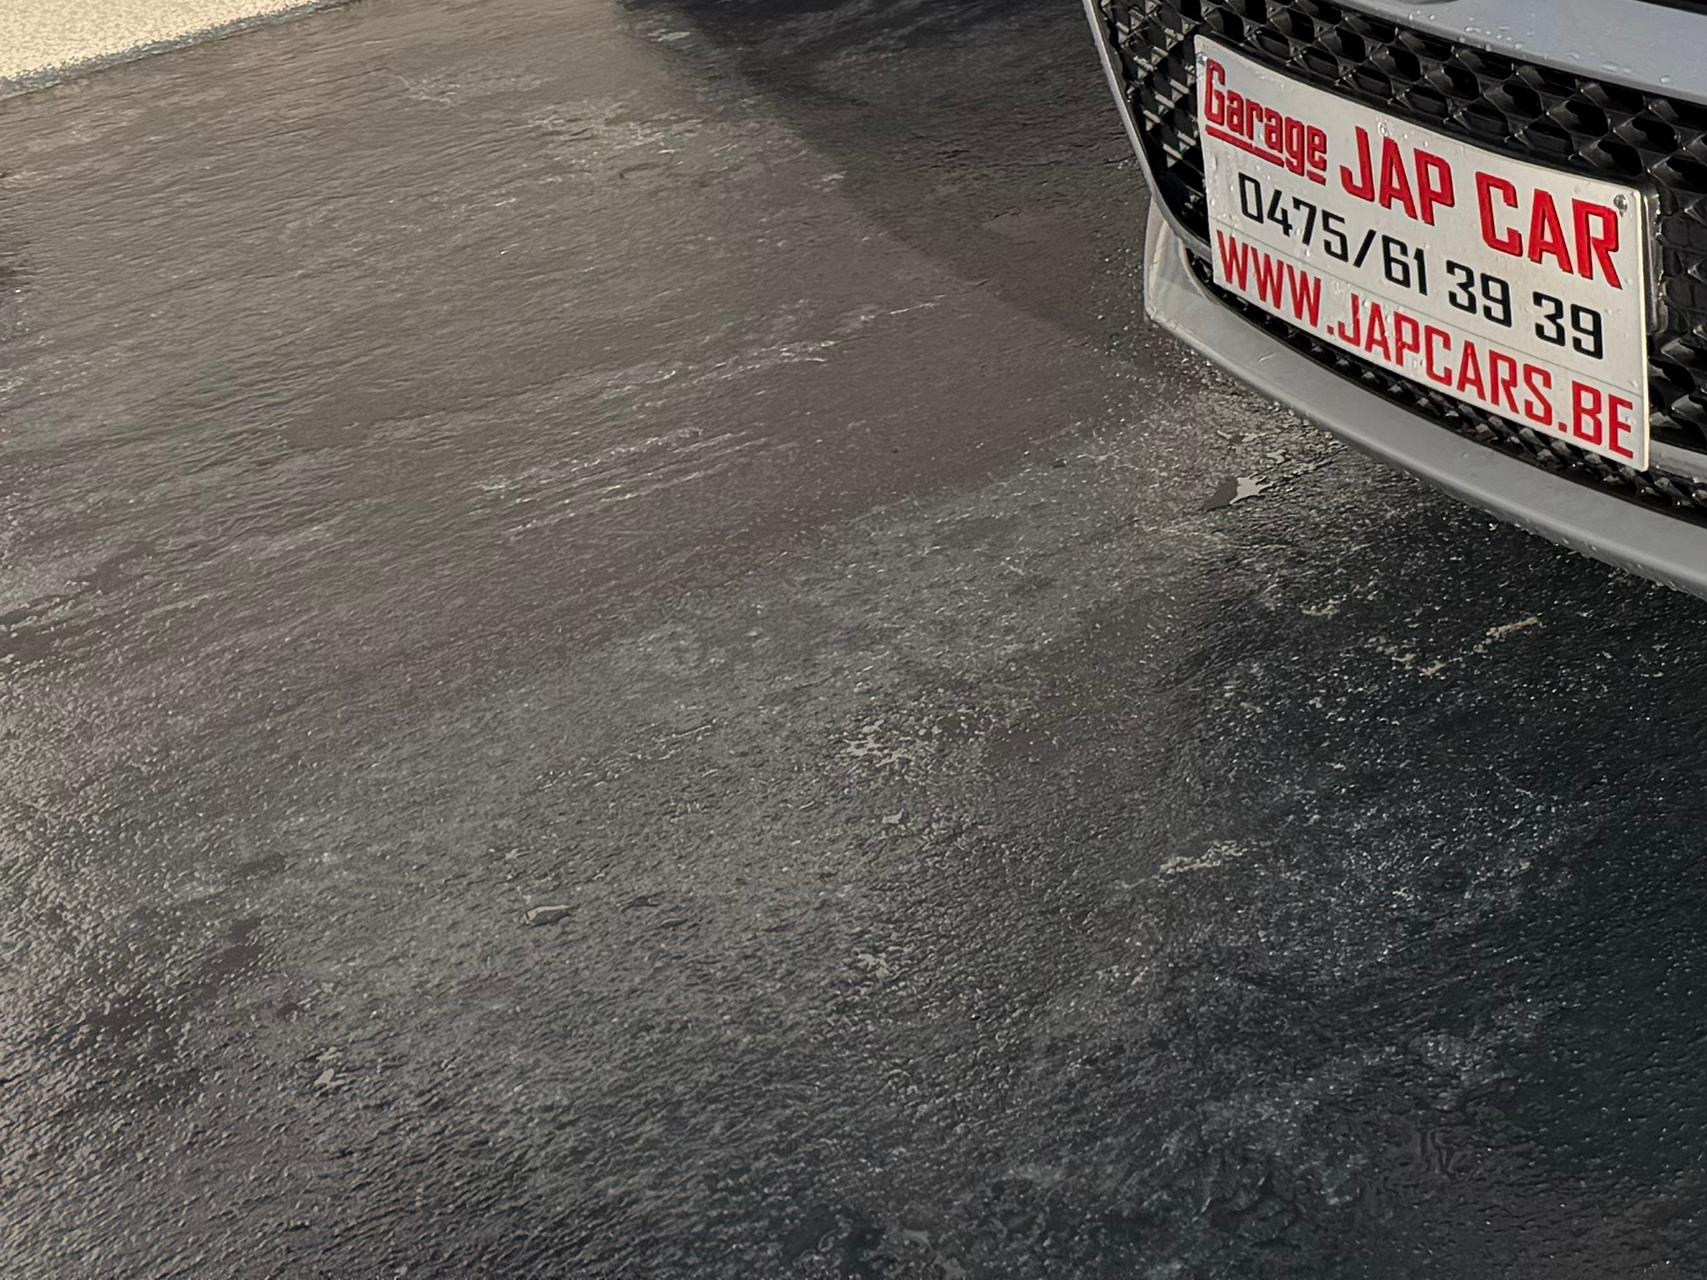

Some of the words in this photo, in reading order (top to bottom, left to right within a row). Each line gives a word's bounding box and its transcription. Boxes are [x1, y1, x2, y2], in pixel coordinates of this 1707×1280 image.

[1203, 57, 1327, 184] Garage
[1340, 126, 1455, 227] JAP
[1476, 170, 1623, 290] CAR
[1238, 172, 1429, 296] 0475/61
[1446, 260, 1513, 328] 39
[1533, 291, 1604, 360] 39
[1217, 228, 1635, 459] WWW.JAPCARS.BE
